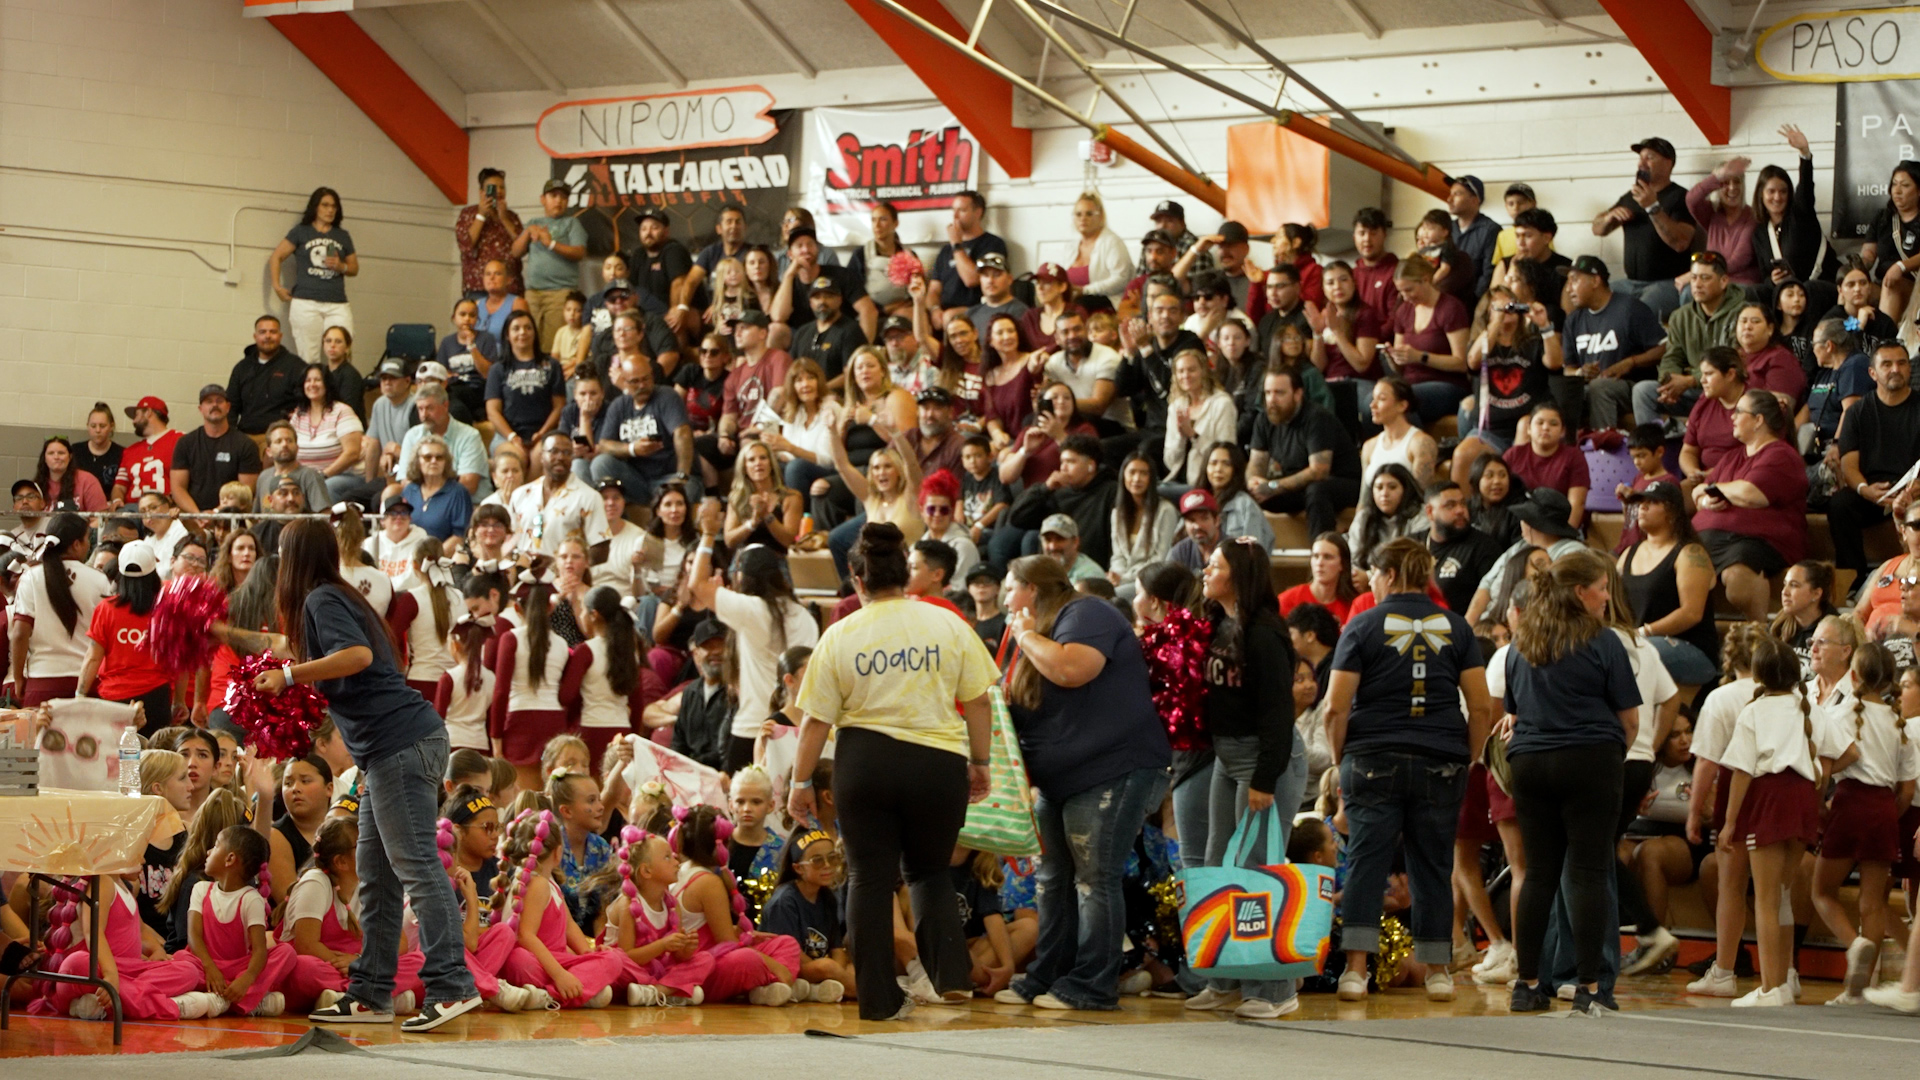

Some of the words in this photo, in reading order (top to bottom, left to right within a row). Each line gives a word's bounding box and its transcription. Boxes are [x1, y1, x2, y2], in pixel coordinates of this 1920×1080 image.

[1791, 17, 1900, 71] PASO
[578, 96, 735, 147] NIPOMO
[826, 126, 973, 189] Smith
[609, 154, 791, 194] TASCADERO
[620, 188, 748, 207] CROSSFIT
[876, 185, 923, 199] MECHANICAL
[1575, 330, 1619, 355] FILA
[130, 459, 165, 499] 13
[467, 796, 496, 814] EAG
[1237, 920, 1266, 932] ALDI
